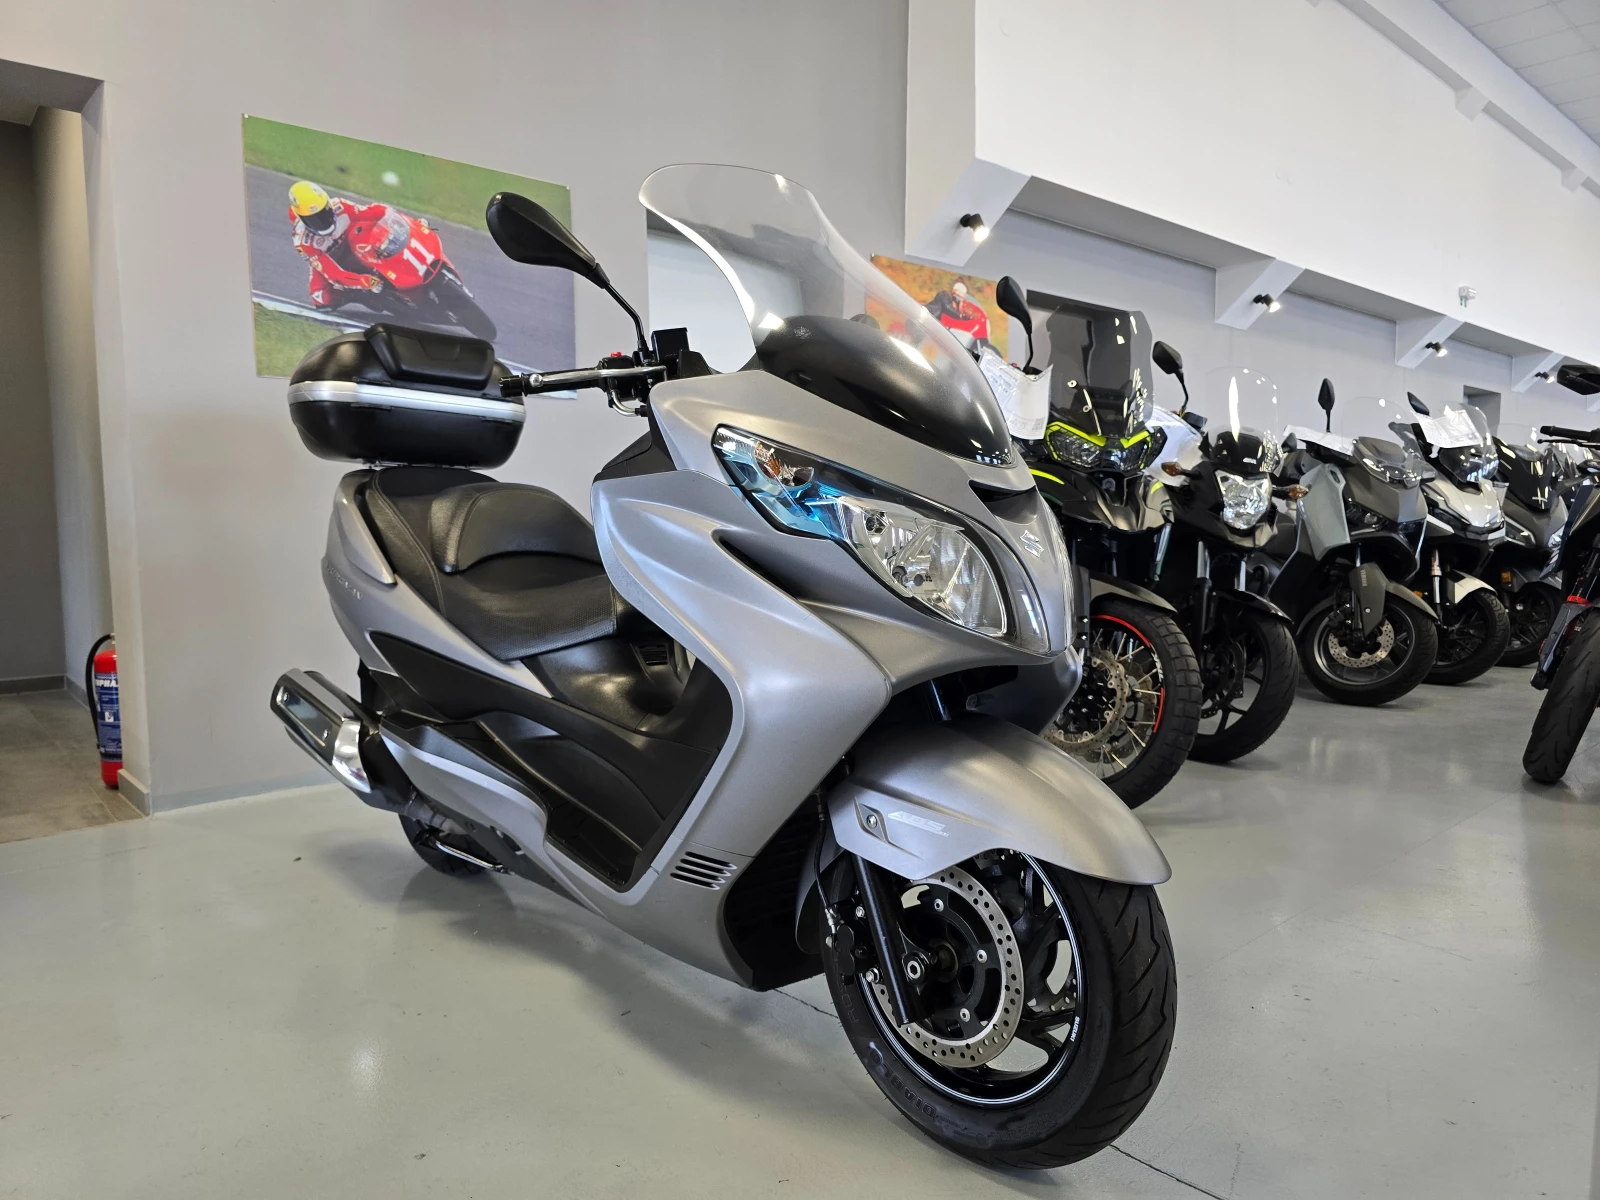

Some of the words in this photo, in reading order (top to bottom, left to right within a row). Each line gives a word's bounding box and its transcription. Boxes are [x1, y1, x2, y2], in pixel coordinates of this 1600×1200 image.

[403, 239, 434, 276] 11
[1070, 1016, 1080, 1042] SUZUKI
[867, 1050, 937, 1120] DIABLO
